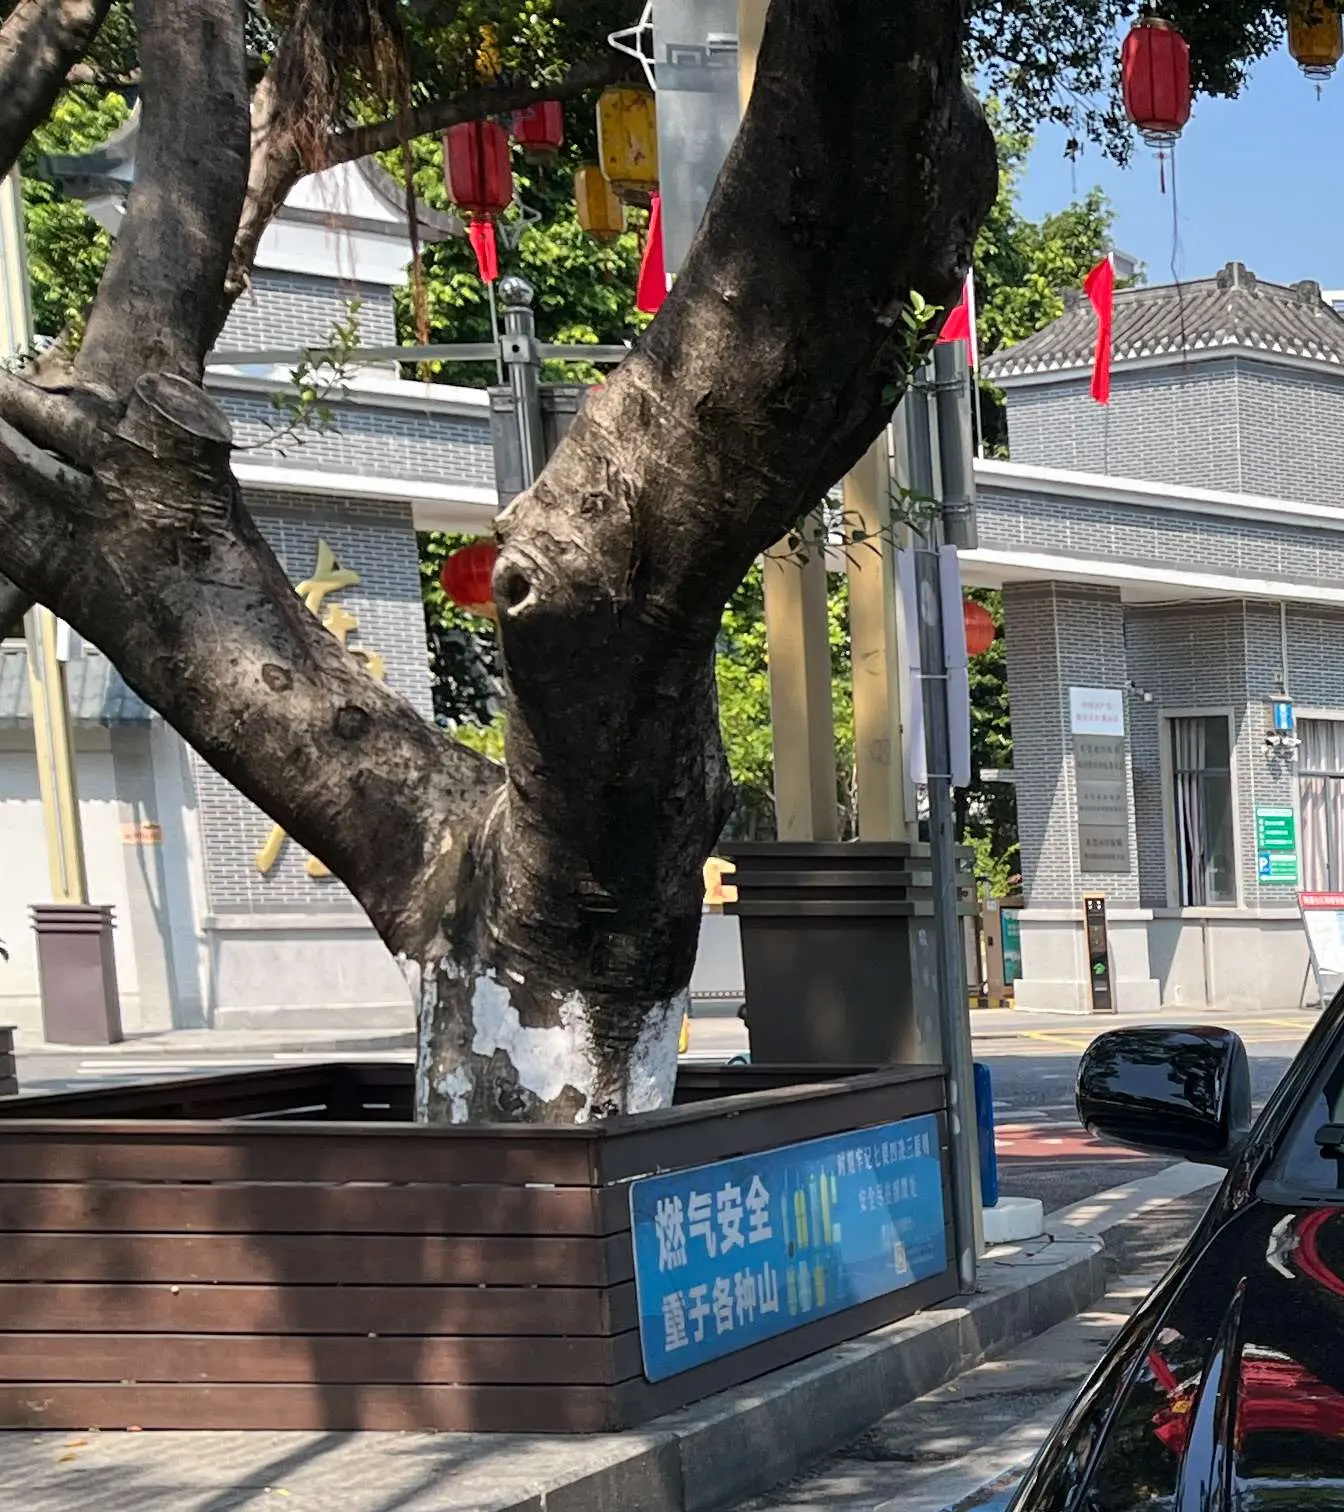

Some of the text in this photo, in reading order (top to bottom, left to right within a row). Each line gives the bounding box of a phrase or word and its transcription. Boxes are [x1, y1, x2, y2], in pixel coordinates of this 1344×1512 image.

[654, 1174, 774, 1273] 燃气安全
[661, 1260, 780, 1352] 重于各种山
